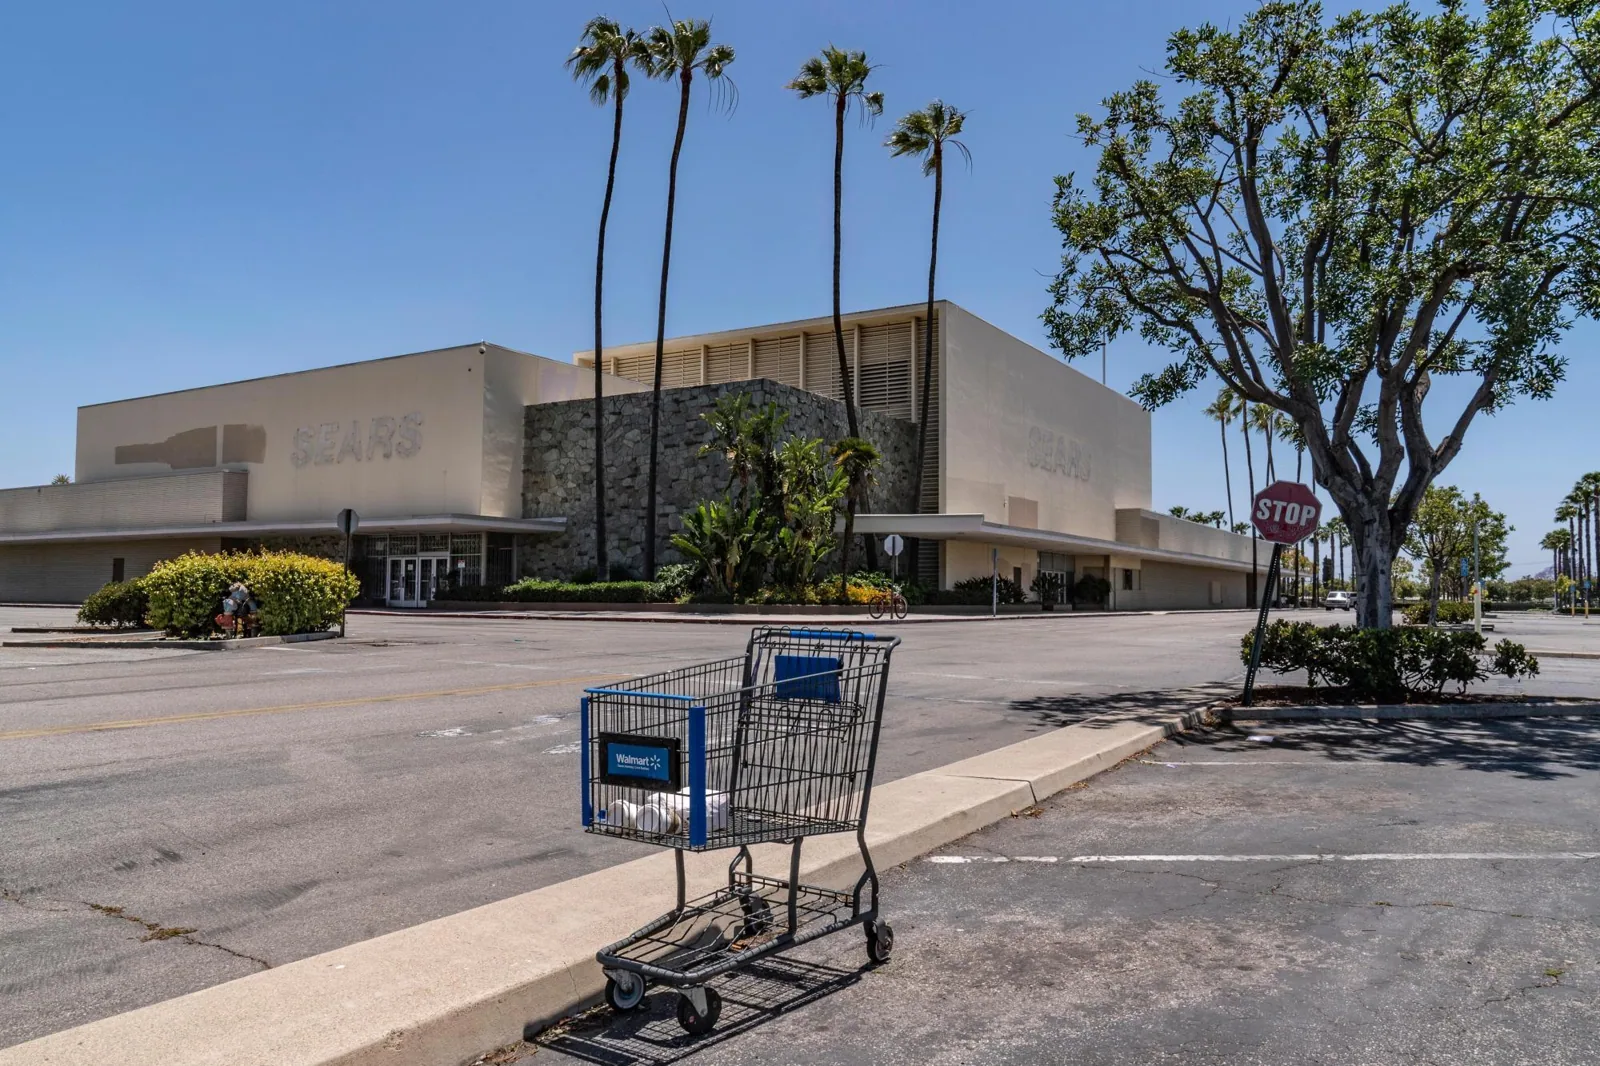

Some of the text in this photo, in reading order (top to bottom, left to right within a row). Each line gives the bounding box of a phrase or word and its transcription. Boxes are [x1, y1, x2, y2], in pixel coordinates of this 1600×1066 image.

[290, 410, 423, 469] SEARS
[1256, 498, 1316, 527] STOP
[615, 753, 650, 767] Walmart
